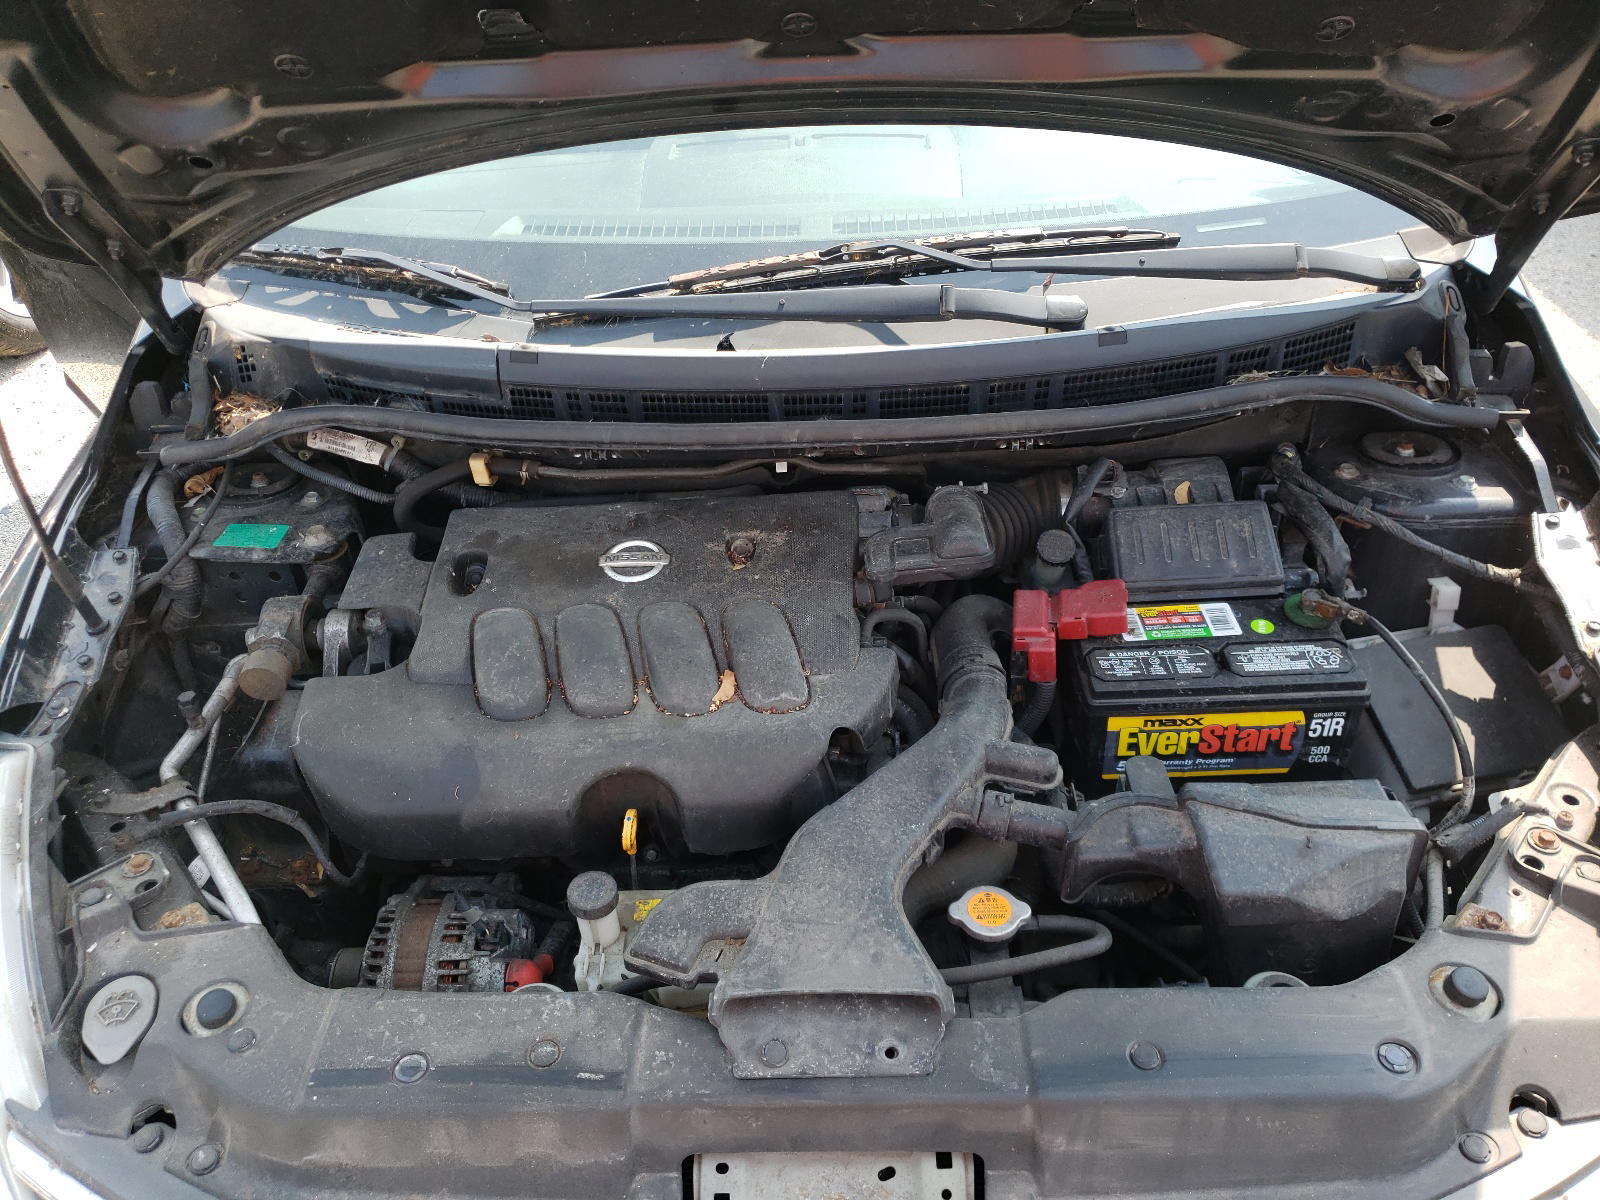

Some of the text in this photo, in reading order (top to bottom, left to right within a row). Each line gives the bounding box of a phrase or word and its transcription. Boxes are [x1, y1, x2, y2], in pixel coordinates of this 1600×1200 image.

[604, 553, 664, 562] NISSAN
[1143, 717, 1204, 728] maxx
[1308, 718, 1345, 738] 51R
[1117, 722, 1297, 757] EverStart
[1311, 745, 1331, 755] 500
[1160, 759, 1193, 767] arranty
[1308, 754, 1328, 763] CCA
